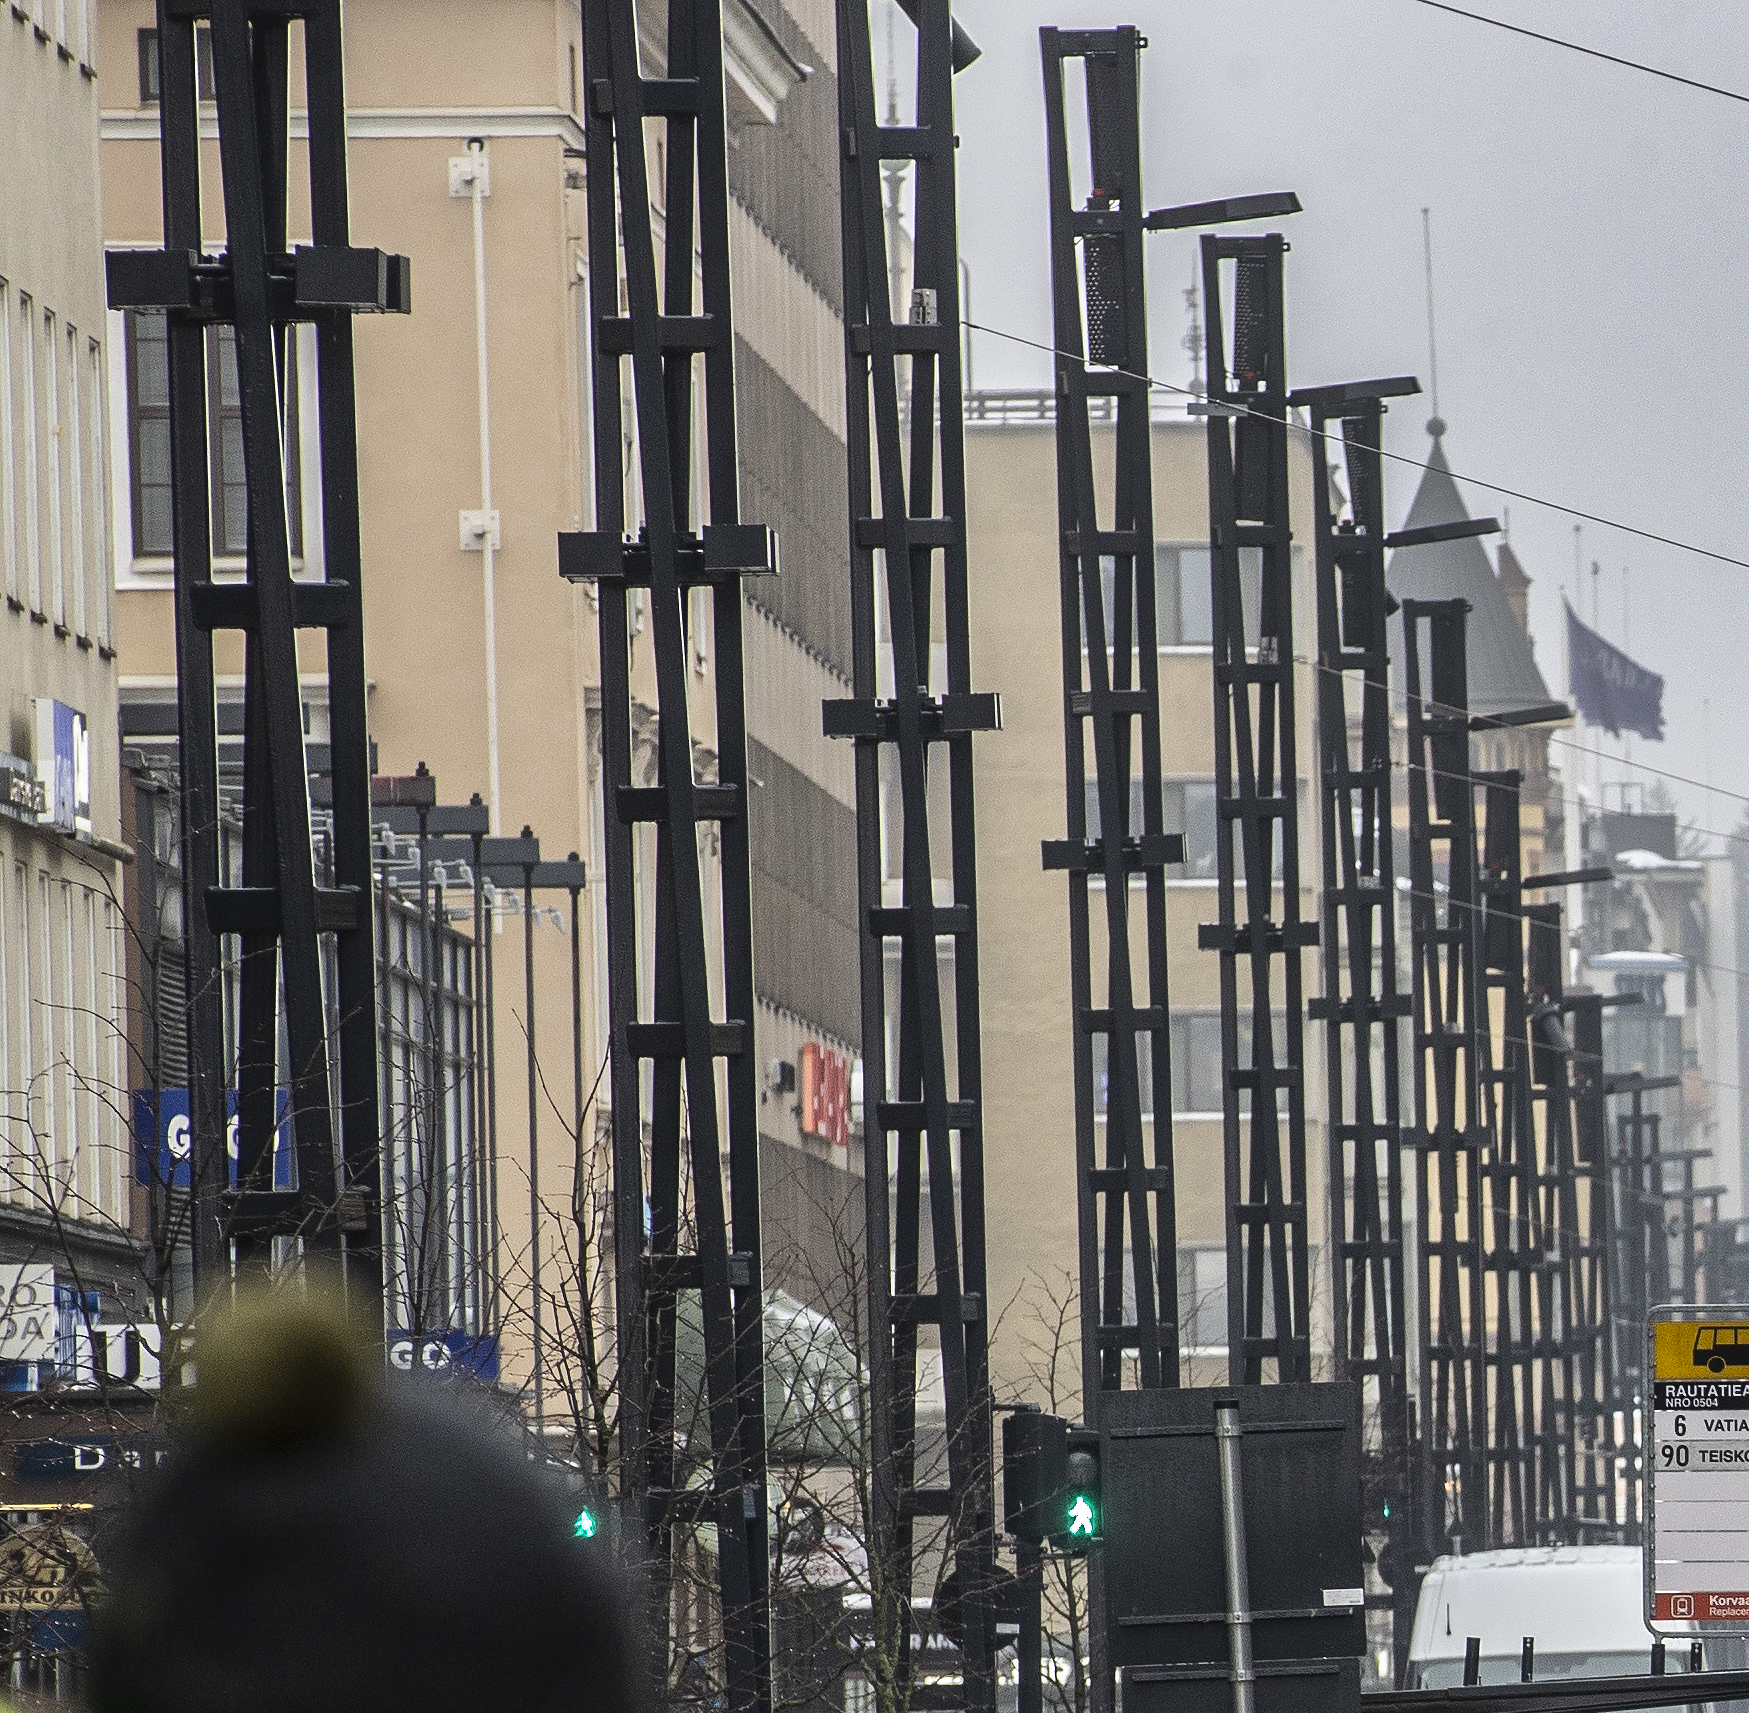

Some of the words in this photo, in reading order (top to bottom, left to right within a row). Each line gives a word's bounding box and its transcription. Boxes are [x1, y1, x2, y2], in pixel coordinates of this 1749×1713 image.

[1665, 1398, 1690, 1407] NRO
[1693, 1398, 1719, 1407] 0504
[1674, 1415, 1687, 1437] 6
[1661, 1445, 1689, 1467] 90
